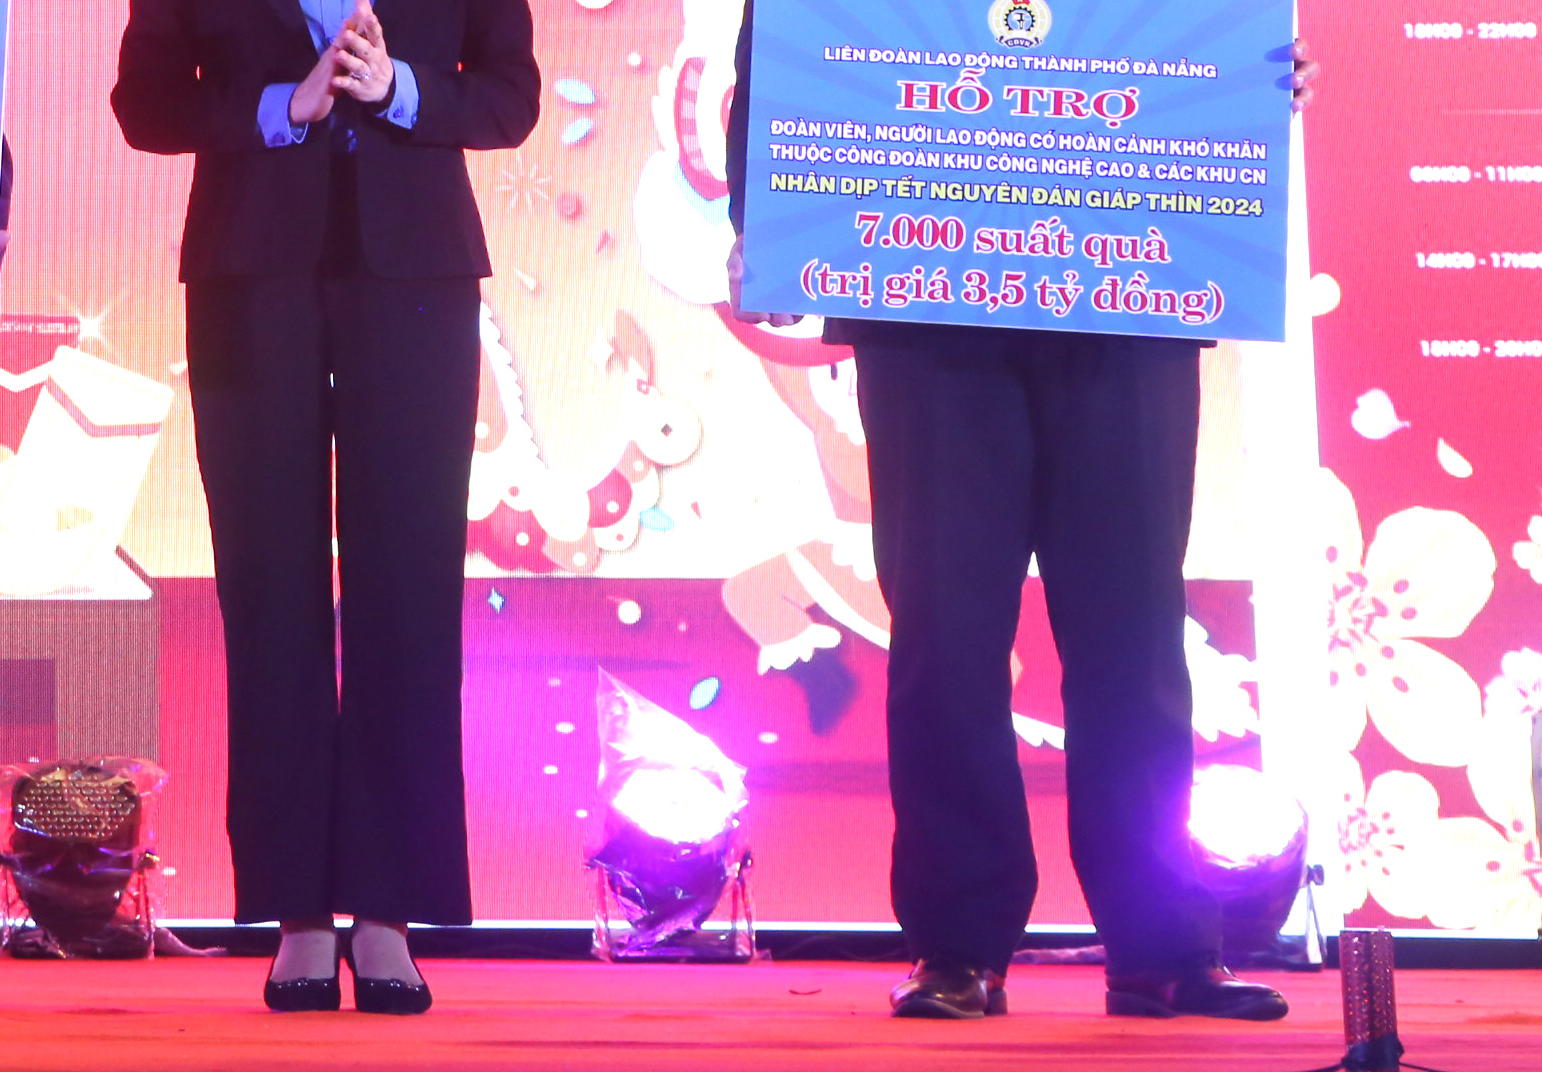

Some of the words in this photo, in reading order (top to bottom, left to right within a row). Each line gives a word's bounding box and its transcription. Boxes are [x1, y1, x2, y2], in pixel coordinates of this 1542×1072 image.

[769, 143, 832, 166] THUỘC
[834, 146, 887, 166] CÔNG
[889, 149, 941, 169] ĐOÀN
[943, 151, 983, 171] KHU
[985, 153, 1038, 173] CÔNG
[1041, 156, 1093, 178] NGHỆ
[1095, 161, 1135, 178] CAO
[1138, 163, 1151, 179] &
[1154, 160, 1193, 181] CÁC
[1196, 165, 1237, 183] KHU
[1240, 167, 1266, 185] CN
[855, 211, 964, 250] 7.000
[974, 217, 1073, 256] suất
[1081, 227, 1170, 266] quà
[800, 259, 873, 309] (trị
[883, 267, 953, 306] giá
[962, 270, 1025, 311] 3,5
[1035, 271, 1082, 315] tỷ
[1092, 271, 1225, 324] đồng)
